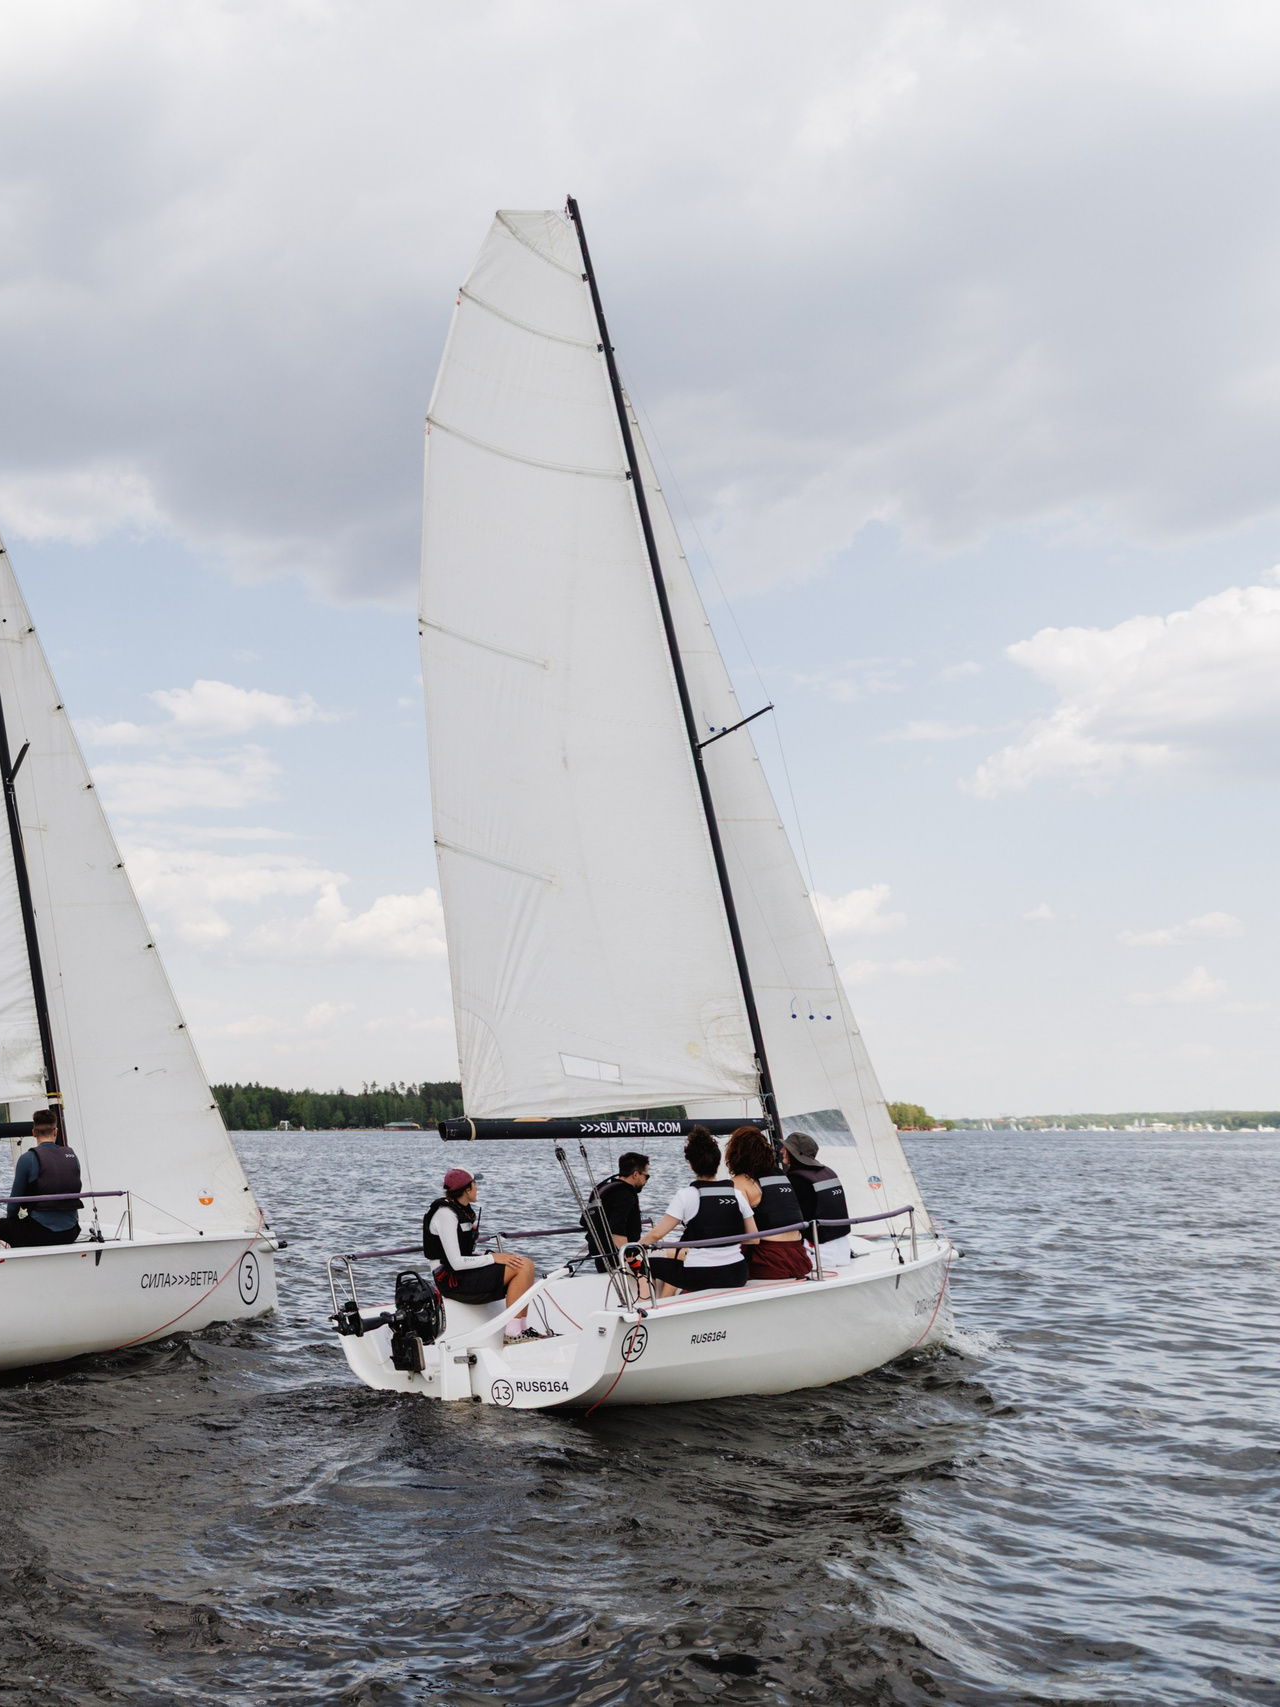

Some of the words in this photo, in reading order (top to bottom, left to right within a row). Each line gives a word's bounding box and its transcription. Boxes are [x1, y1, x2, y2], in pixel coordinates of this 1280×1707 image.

[624, 1334, 645, 1355] 13
[690, 1330, 727, 1345] RUS6164
[516, 1381, 569, 1392] RUS6164
